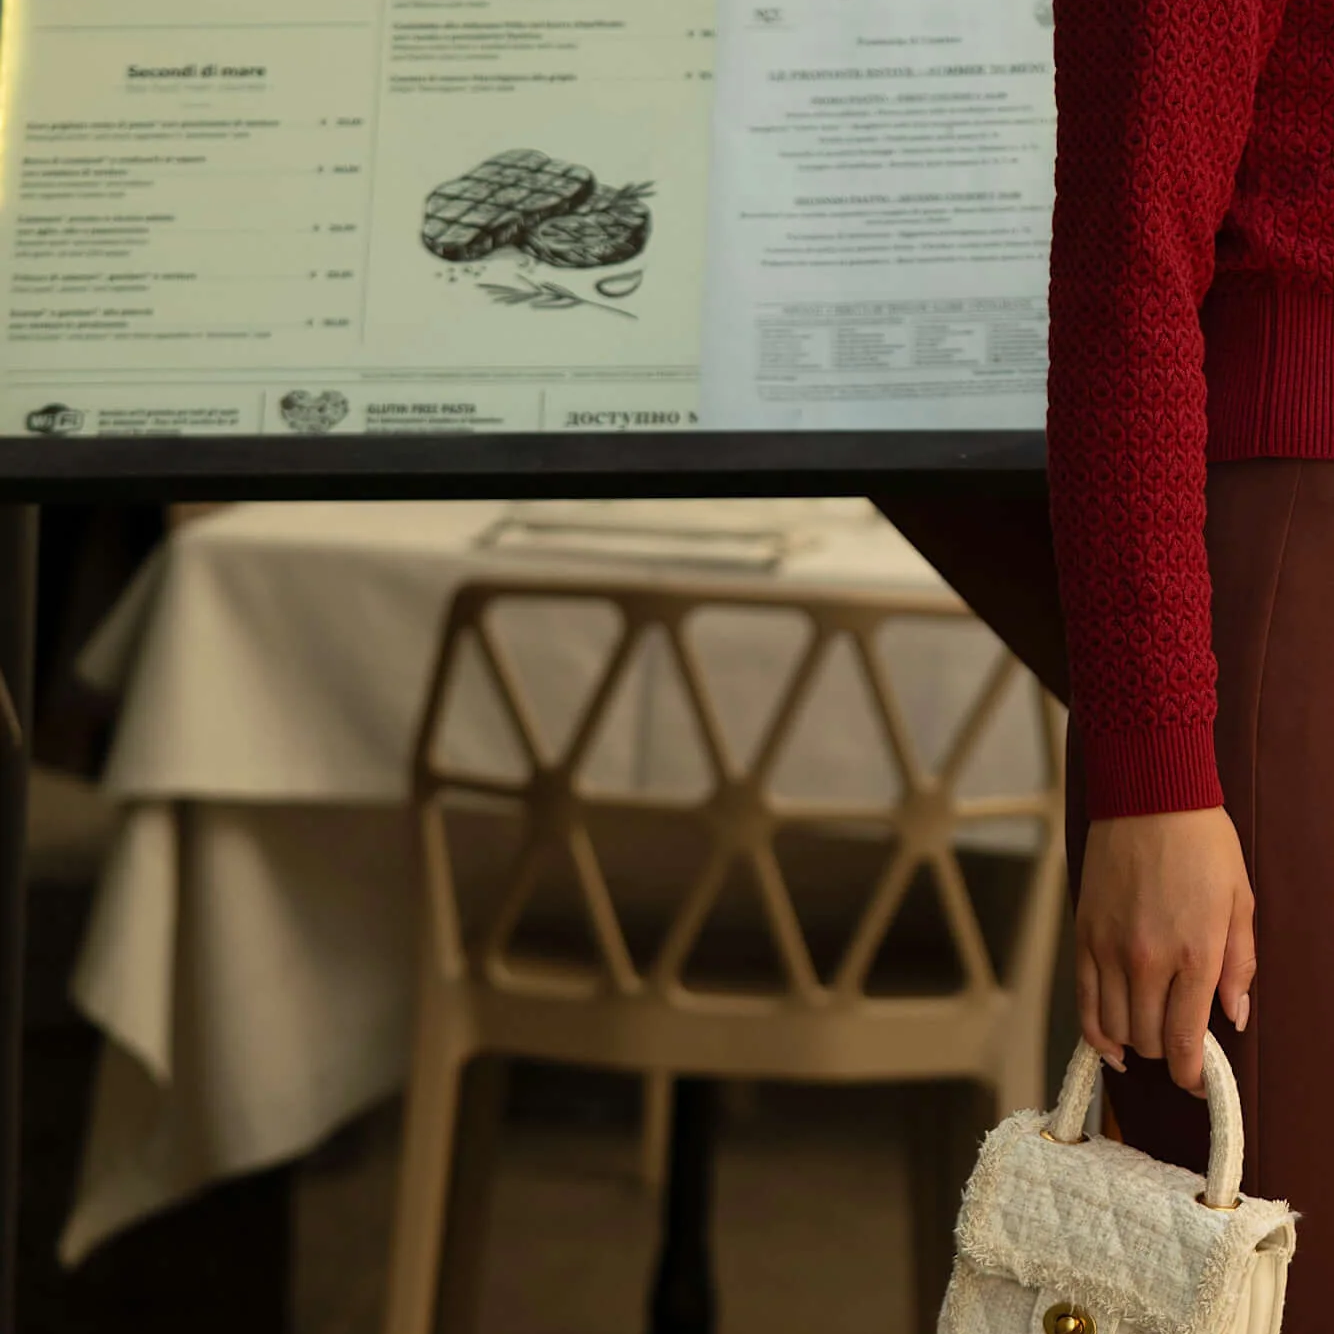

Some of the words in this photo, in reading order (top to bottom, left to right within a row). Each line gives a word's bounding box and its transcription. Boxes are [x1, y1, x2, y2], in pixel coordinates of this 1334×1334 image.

[127, 64, 197, 78] Secondi
[200, 63, 218, 78] di
[221, 65, 267, 78] mare
